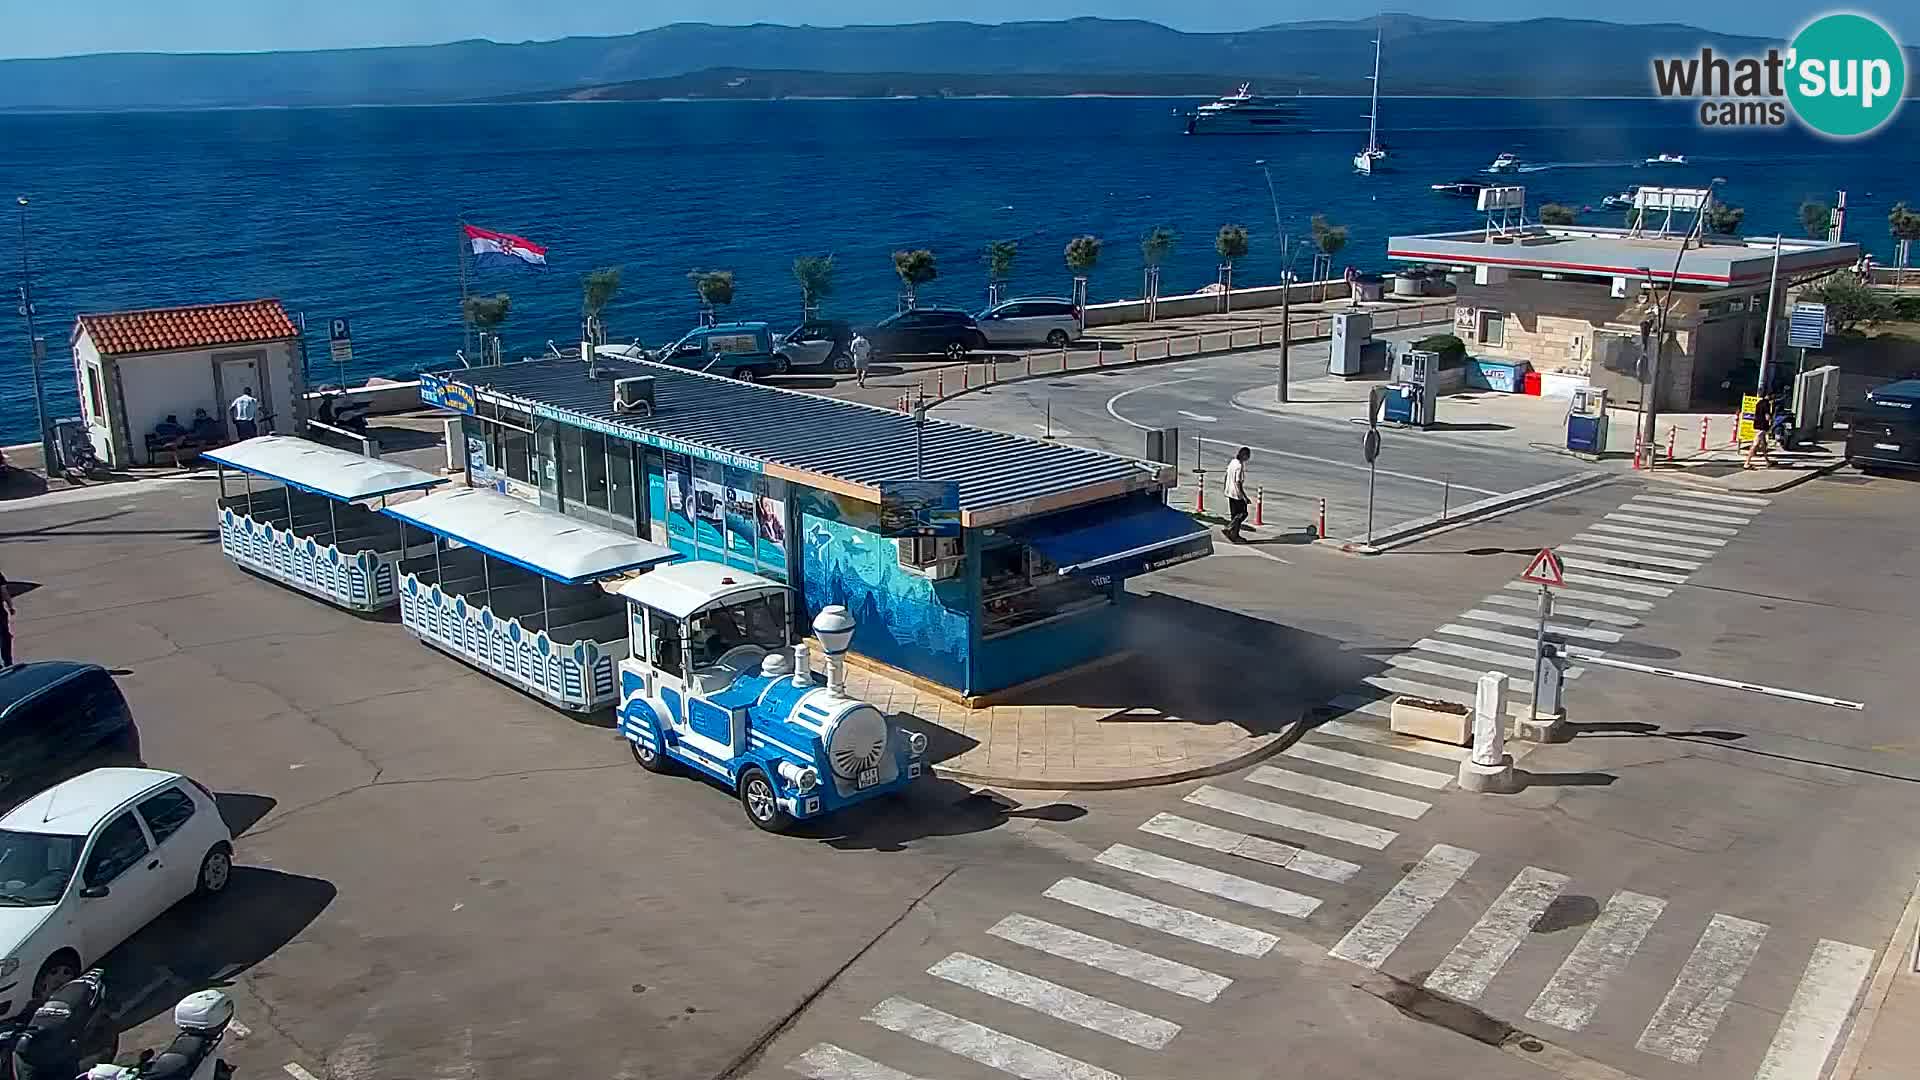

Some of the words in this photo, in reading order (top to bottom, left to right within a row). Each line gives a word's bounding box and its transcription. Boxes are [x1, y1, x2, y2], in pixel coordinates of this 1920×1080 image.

[619, 427, 649, 444] POSTAJA
[660, 438, 673, 450] BUS
[674, 442, 705, 458] STATION
[708, 450, 731, 464] TICKET
[733, 456, 760, 470] OFFICE
